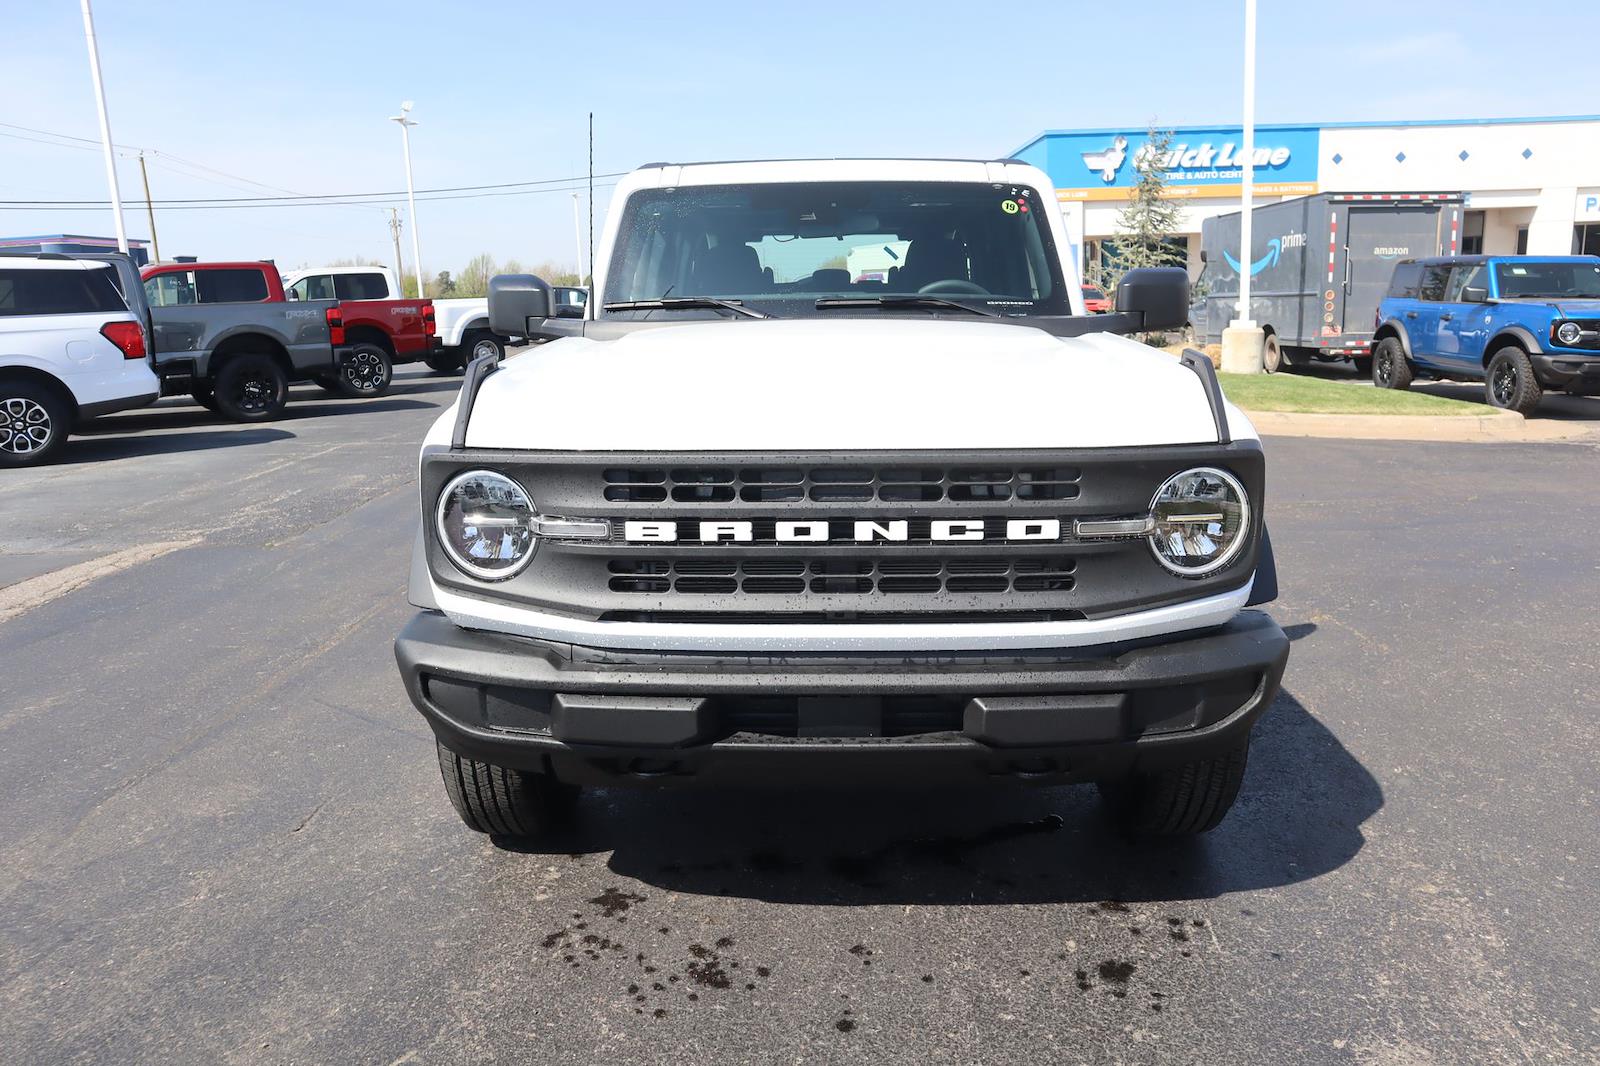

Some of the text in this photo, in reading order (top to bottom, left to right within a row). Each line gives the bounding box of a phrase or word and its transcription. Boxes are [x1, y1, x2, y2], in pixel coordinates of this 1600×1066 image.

[1165, 171, 1185, 180] TIRE
[1194, 170, 1218, 179] AUTO
[1219, 169, 1255, 178] CENT
[1005, 202, 1016, 212] 19
[1281, 229, 1307, 253] prime
[1373, 246, 1409, 255] amazon
[624, 519, 1060, 542] BRONCO
